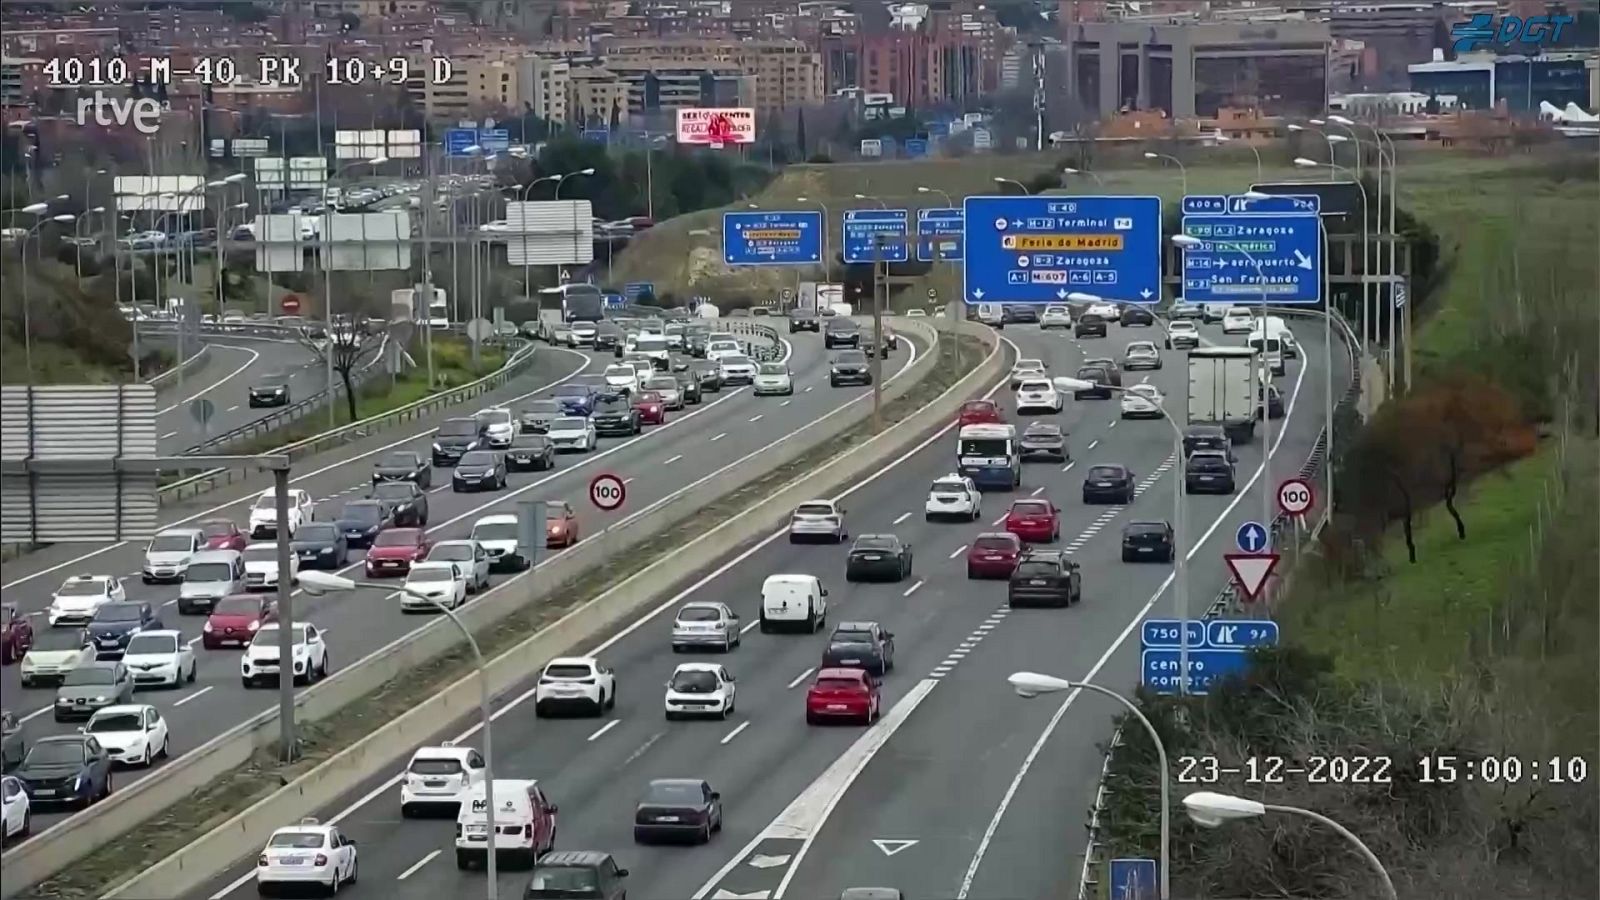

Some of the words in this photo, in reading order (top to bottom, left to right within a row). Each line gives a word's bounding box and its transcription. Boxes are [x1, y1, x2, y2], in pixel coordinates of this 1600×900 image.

[1188, 200, 1211, 208] 400
[1058, 218, 1108, 228] Terminal
[1237, 226, 1295, 236] Zaragoza
[1022, 237, 1053, 247] Feria
[1058, 238, 1072, 247] de
[1077, 237, 1119, 247] Madrid
[1056, 256, 1110, 266] Zaragoza
[1231, 258, 1296, 267] aeropuerto
[1211, 274, 1233, 283] San
[1240, 274, 1299, 283] Fernando
[595, 486, 620, 499] 100
[1282, 491, 1309, 503] 100
[1150, 628, 1179, 639] 750
[1250, 629, 1268, 640] 9A
[1150, 661, 1205, 671] cenro
